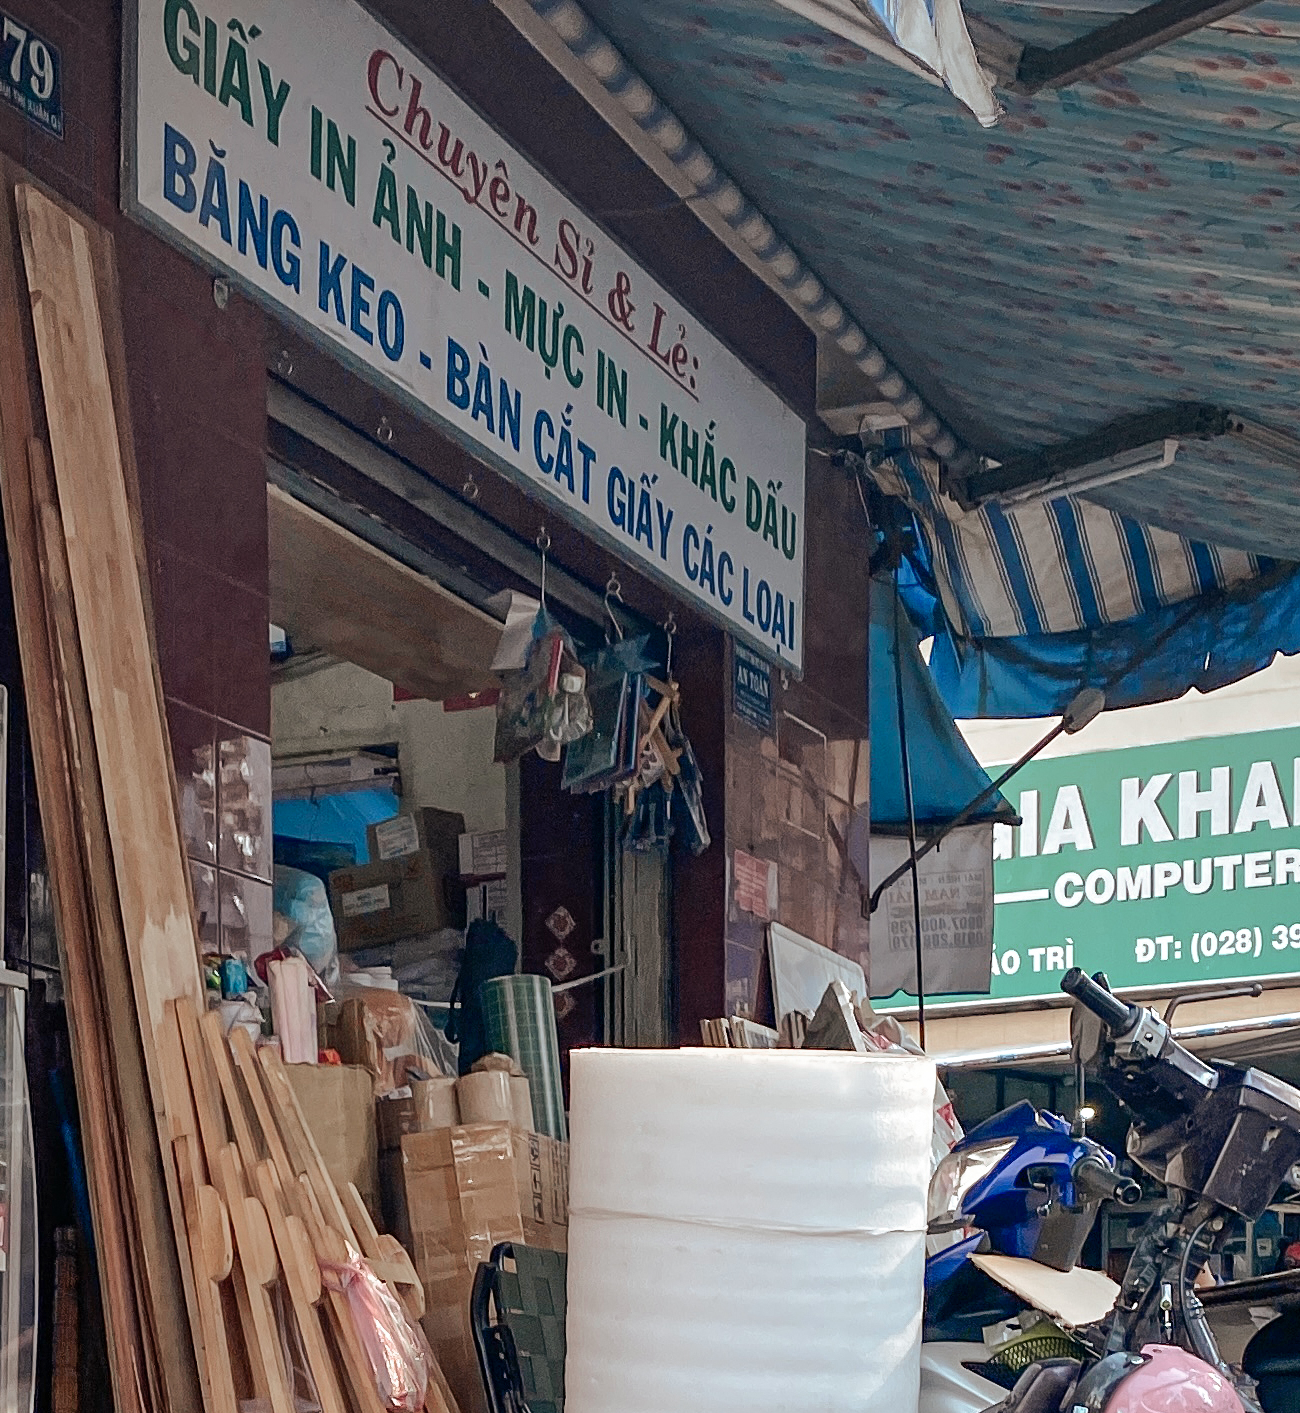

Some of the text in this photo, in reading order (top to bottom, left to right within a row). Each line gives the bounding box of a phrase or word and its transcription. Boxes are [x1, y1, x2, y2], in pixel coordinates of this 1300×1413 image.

[2, 16, 54, 99] 79
[163, 0, 291, 147] GIẤY
[310, 105, 357, 208] IN
[372, 137, 462, 292] ẢNH
[504, 269, 586, 389] MỰC
[597, 348, 628, 429] IN
[660, 402, 737, 514] KHẮC
[746, 474, 797, 562] DẤU
[368, 49, 700, 390] Chuyên Sỉ & Lẻ:
[163, 122, 303, 295] BĂNG
[318, 239, 405, 363] KEO
[447, 336, 522, 453] BÀN
[533, 403, 597, 505] CẮT
[607, 465, 674, 562] GIẤY
[683, 525, 734, 607] CÁC
[743, 566, 795, 655] LOẠI
[1027, 937, 1075, 975] TRÌ
[1134, 935, 1183, 963] ĐT:
[1190, 925, 1263, 963] (028)
